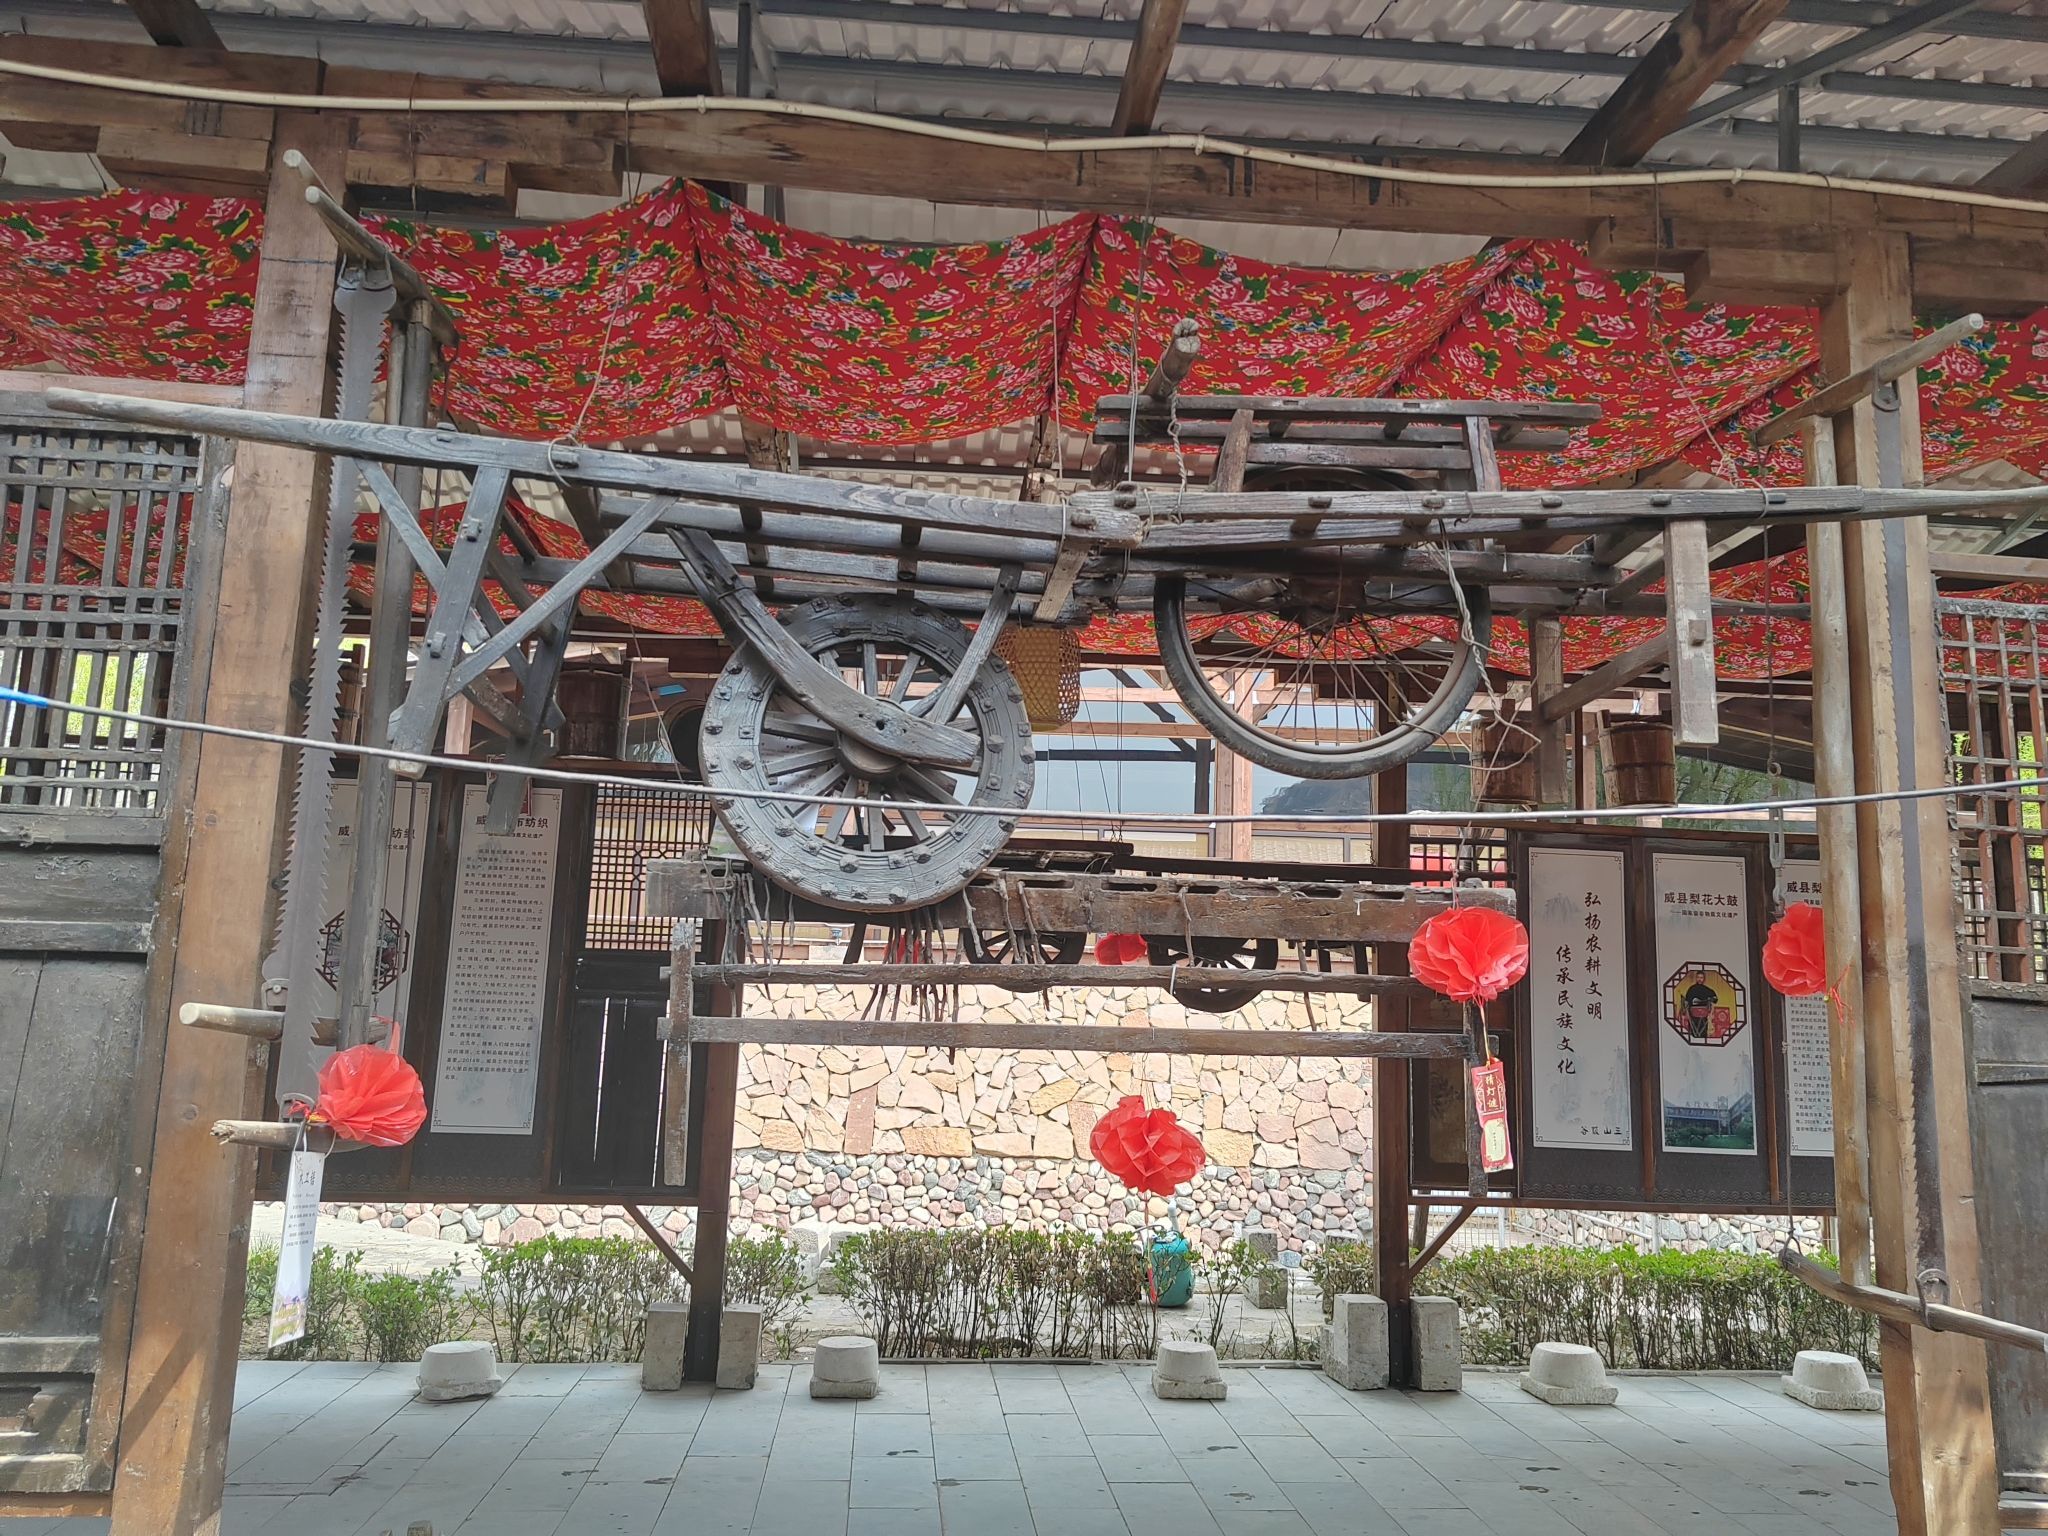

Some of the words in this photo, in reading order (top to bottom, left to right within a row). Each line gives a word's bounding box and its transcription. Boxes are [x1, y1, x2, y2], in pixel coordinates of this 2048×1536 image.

[476, 815, 549, 829] 威布纺织
[1664, 892, 1739, 907] 威县梨花大鼓
[1584, 891, 1603, 1021] 弘扬农耕文明
[1556, 943, 1576, 1075] 传承民族文化
